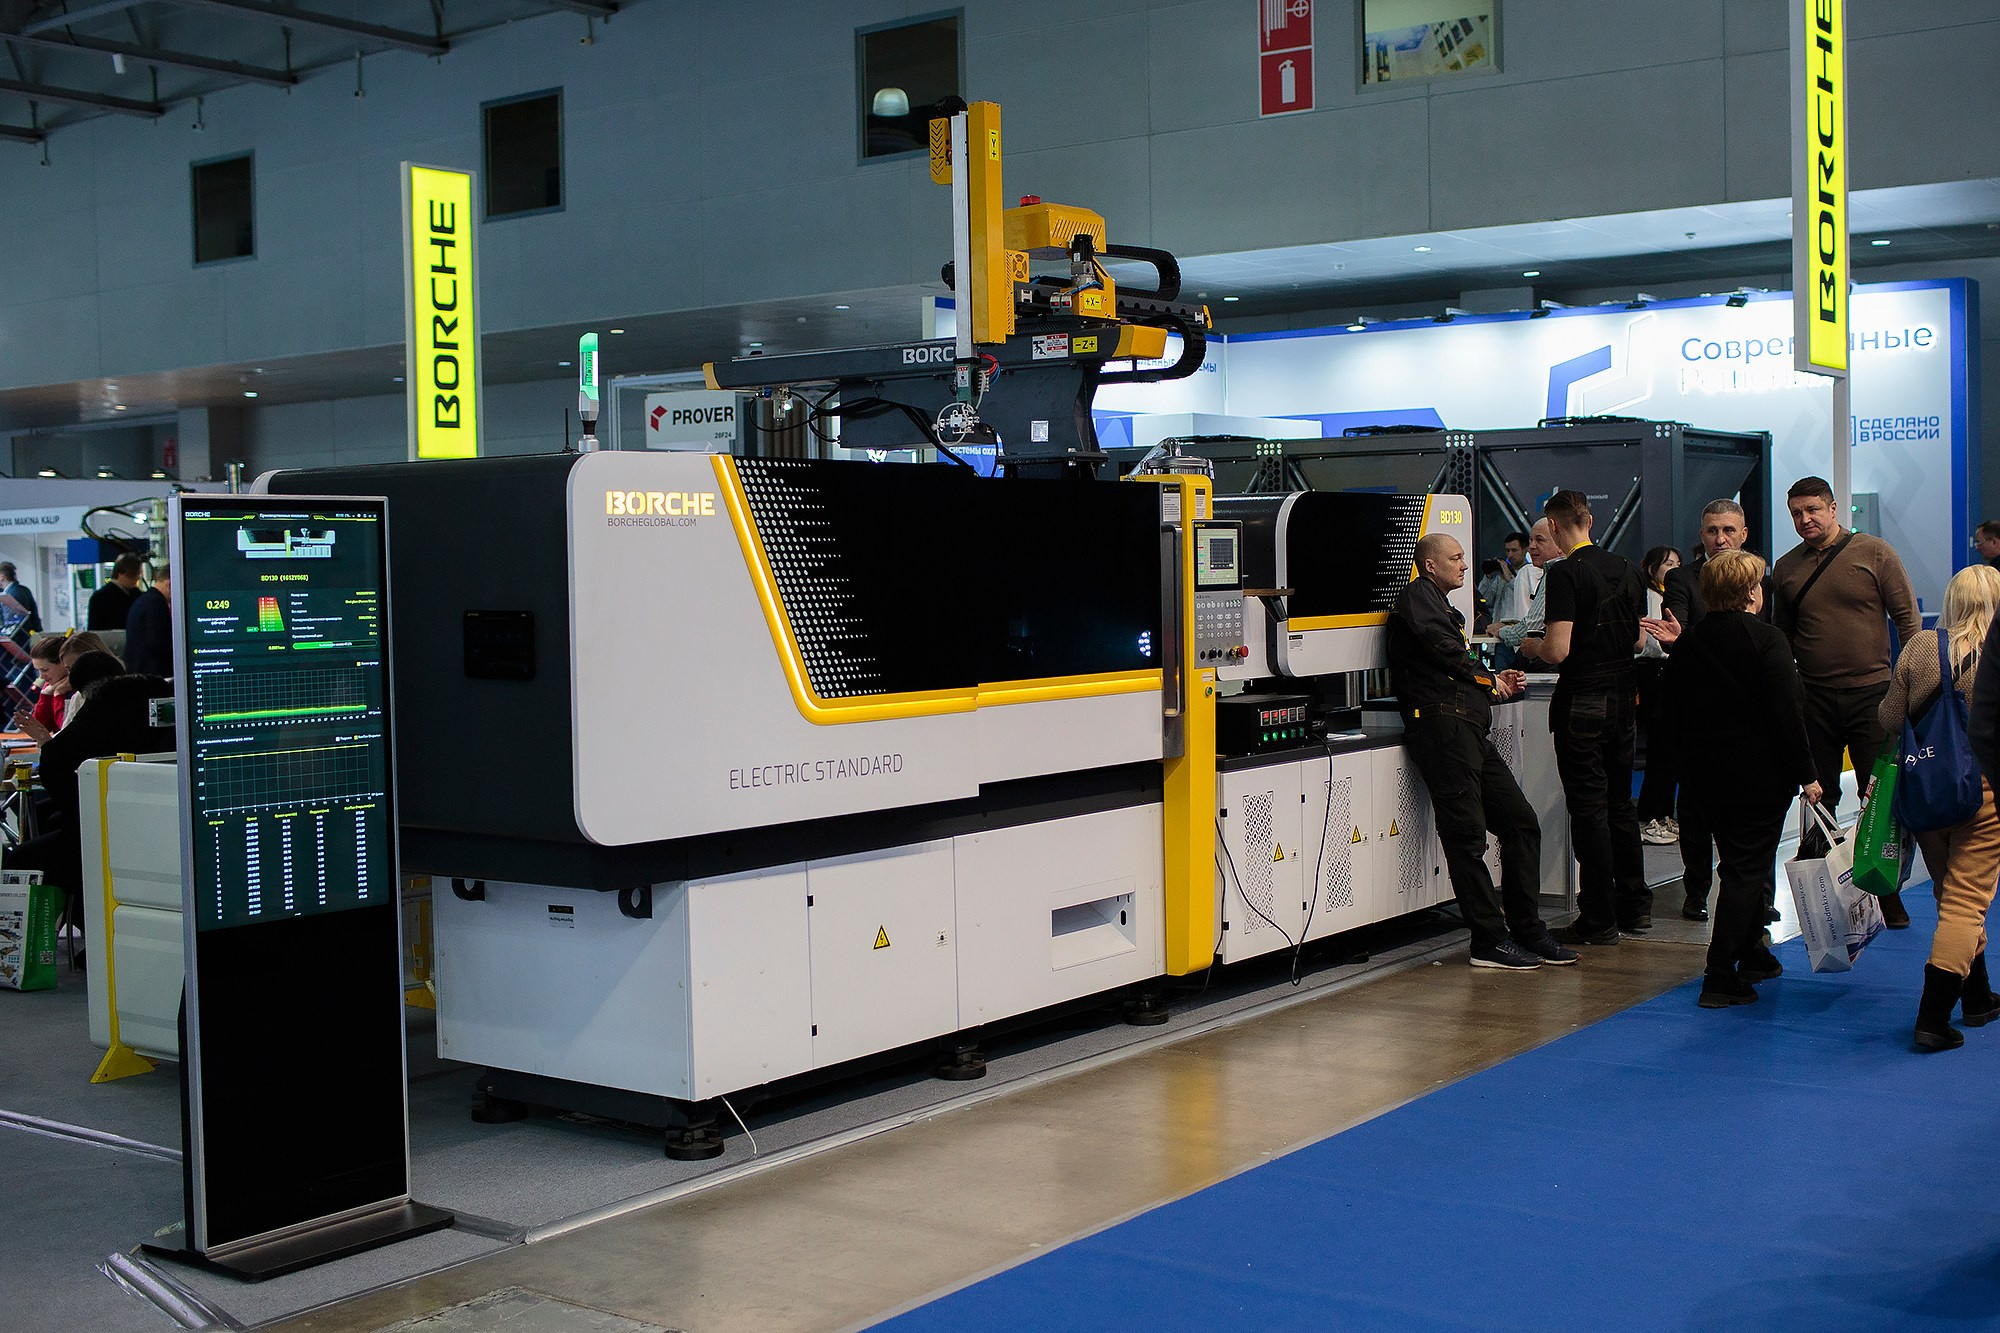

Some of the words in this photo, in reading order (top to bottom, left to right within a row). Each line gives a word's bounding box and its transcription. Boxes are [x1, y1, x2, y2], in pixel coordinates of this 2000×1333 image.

[1816, 0, 1836, 324] BORCHE
[429, 199, 461, 429] BORCHE
[903, 346, 957, 363] BORC
[1681, 327, 1933, 364] Совреные
[672, 406, 734, 425] PROVER
[1860, 416, 1940, 430] СДЕЛАНО
[606, 490, 716, 516] BORCHE
[607, 518, 697, 527] BORCHEGLOBAL.COM
[1440, 510, 1463, 525] BD130
[206, 600, 230, 610] 0.249
[730, 761, 811, 790] ELECTRIC
[815, 753, 904, 782] STANDARD
